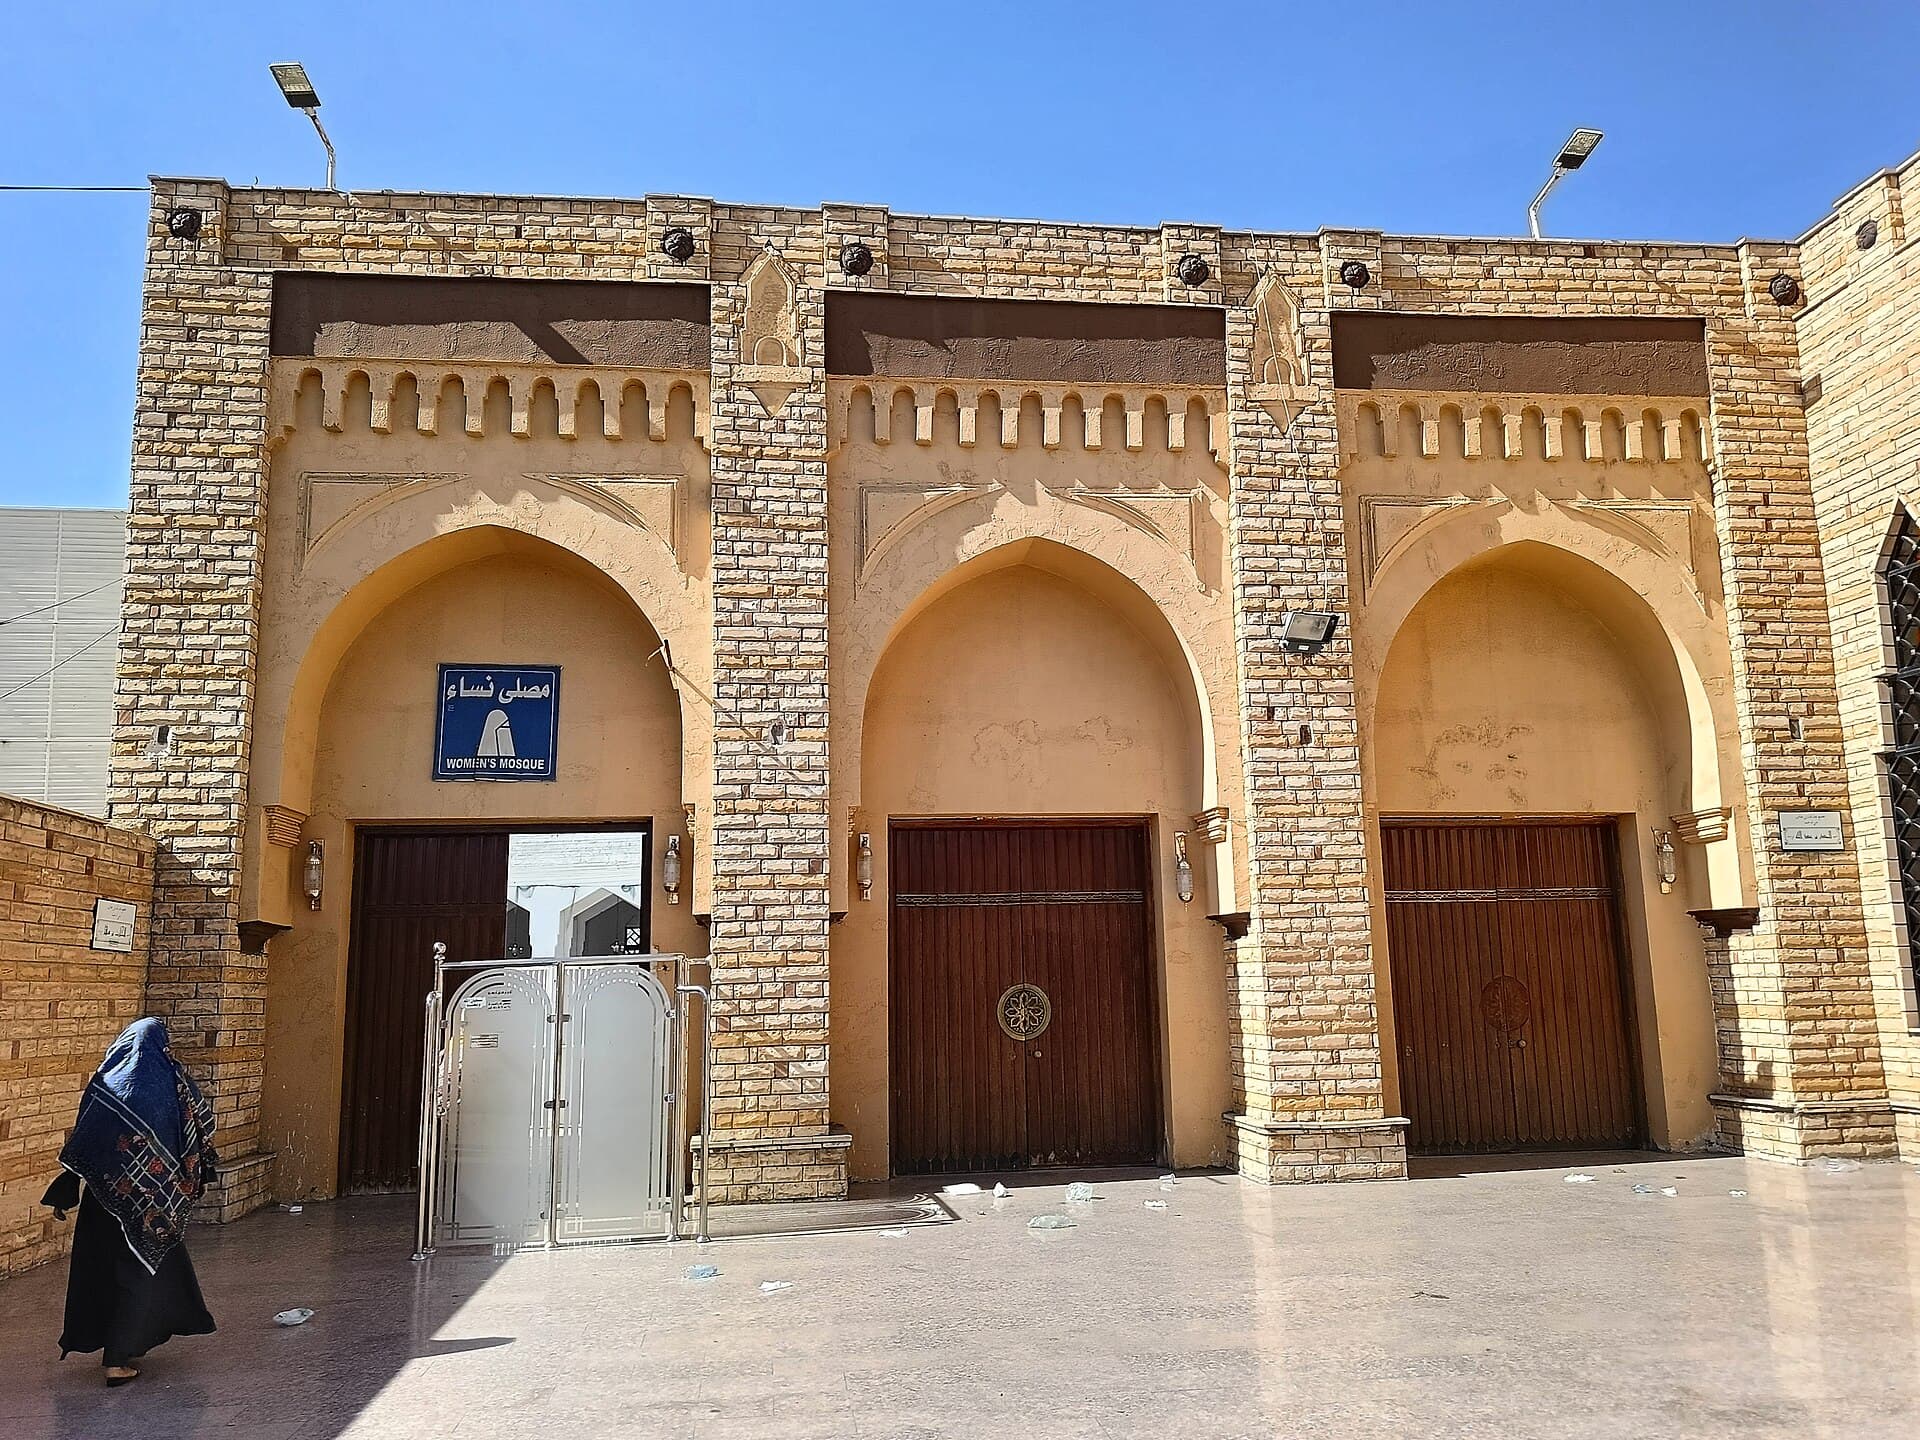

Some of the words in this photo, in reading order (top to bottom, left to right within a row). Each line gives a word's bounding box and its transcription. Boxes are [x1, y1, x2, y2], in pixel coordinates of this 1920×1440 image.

[446, 674, 495, 701] نساء
[498, 676, 550, 704] مصلى
[446, 757, 497, 770] WOMEN'S
[499, 758, 545, 771] MOSQUE
